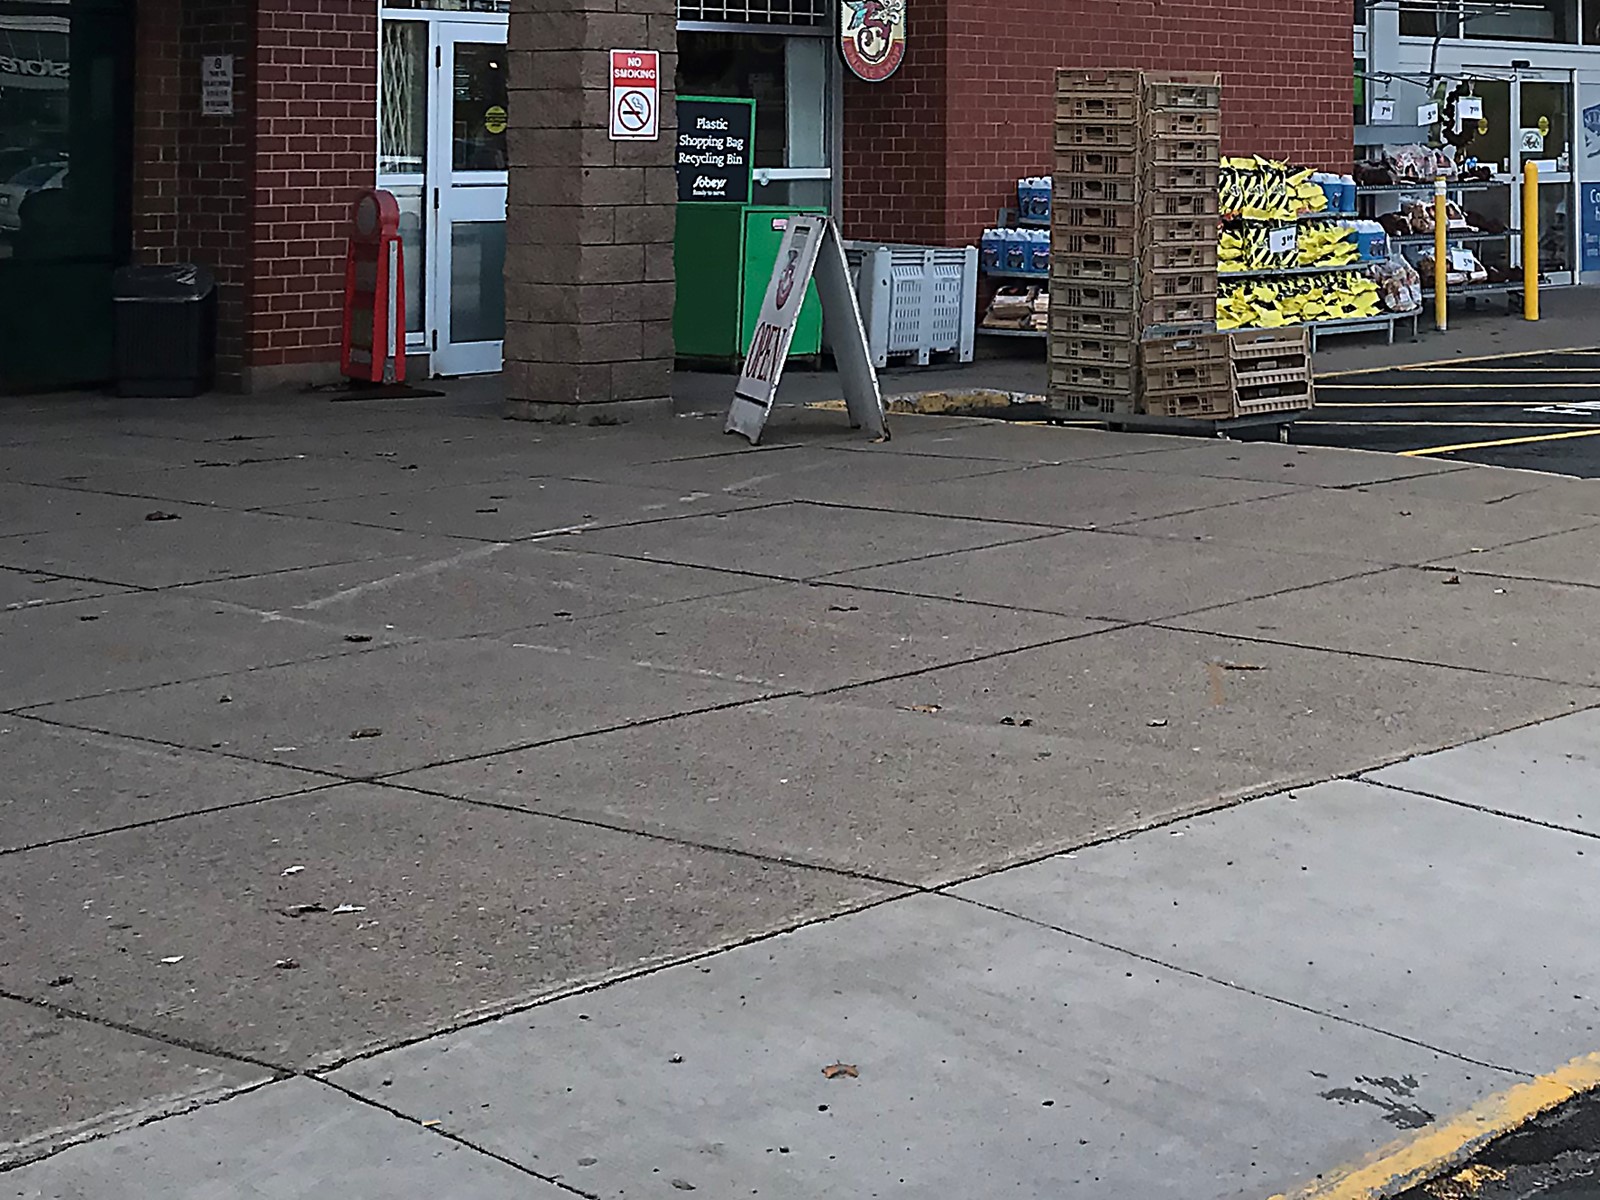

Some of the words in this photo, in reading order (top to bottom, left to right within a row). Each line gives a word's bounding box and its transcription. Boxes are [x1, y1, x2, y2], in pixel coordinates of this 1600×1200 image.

[627, 57, 642, 67] NO
[614, 69, 656, 80] SMOKING
[696, 118, 728, 130] Plastic
[679, 134, 724, 150] Shopping
[726, 137, 744, 150] Bag
[678, 152, 725, 167] Recycling
[726, 153, 743, 165] Bin
[693, 176, 727, 190] Sobeys
[745, 321, 788, 382] OPEN
